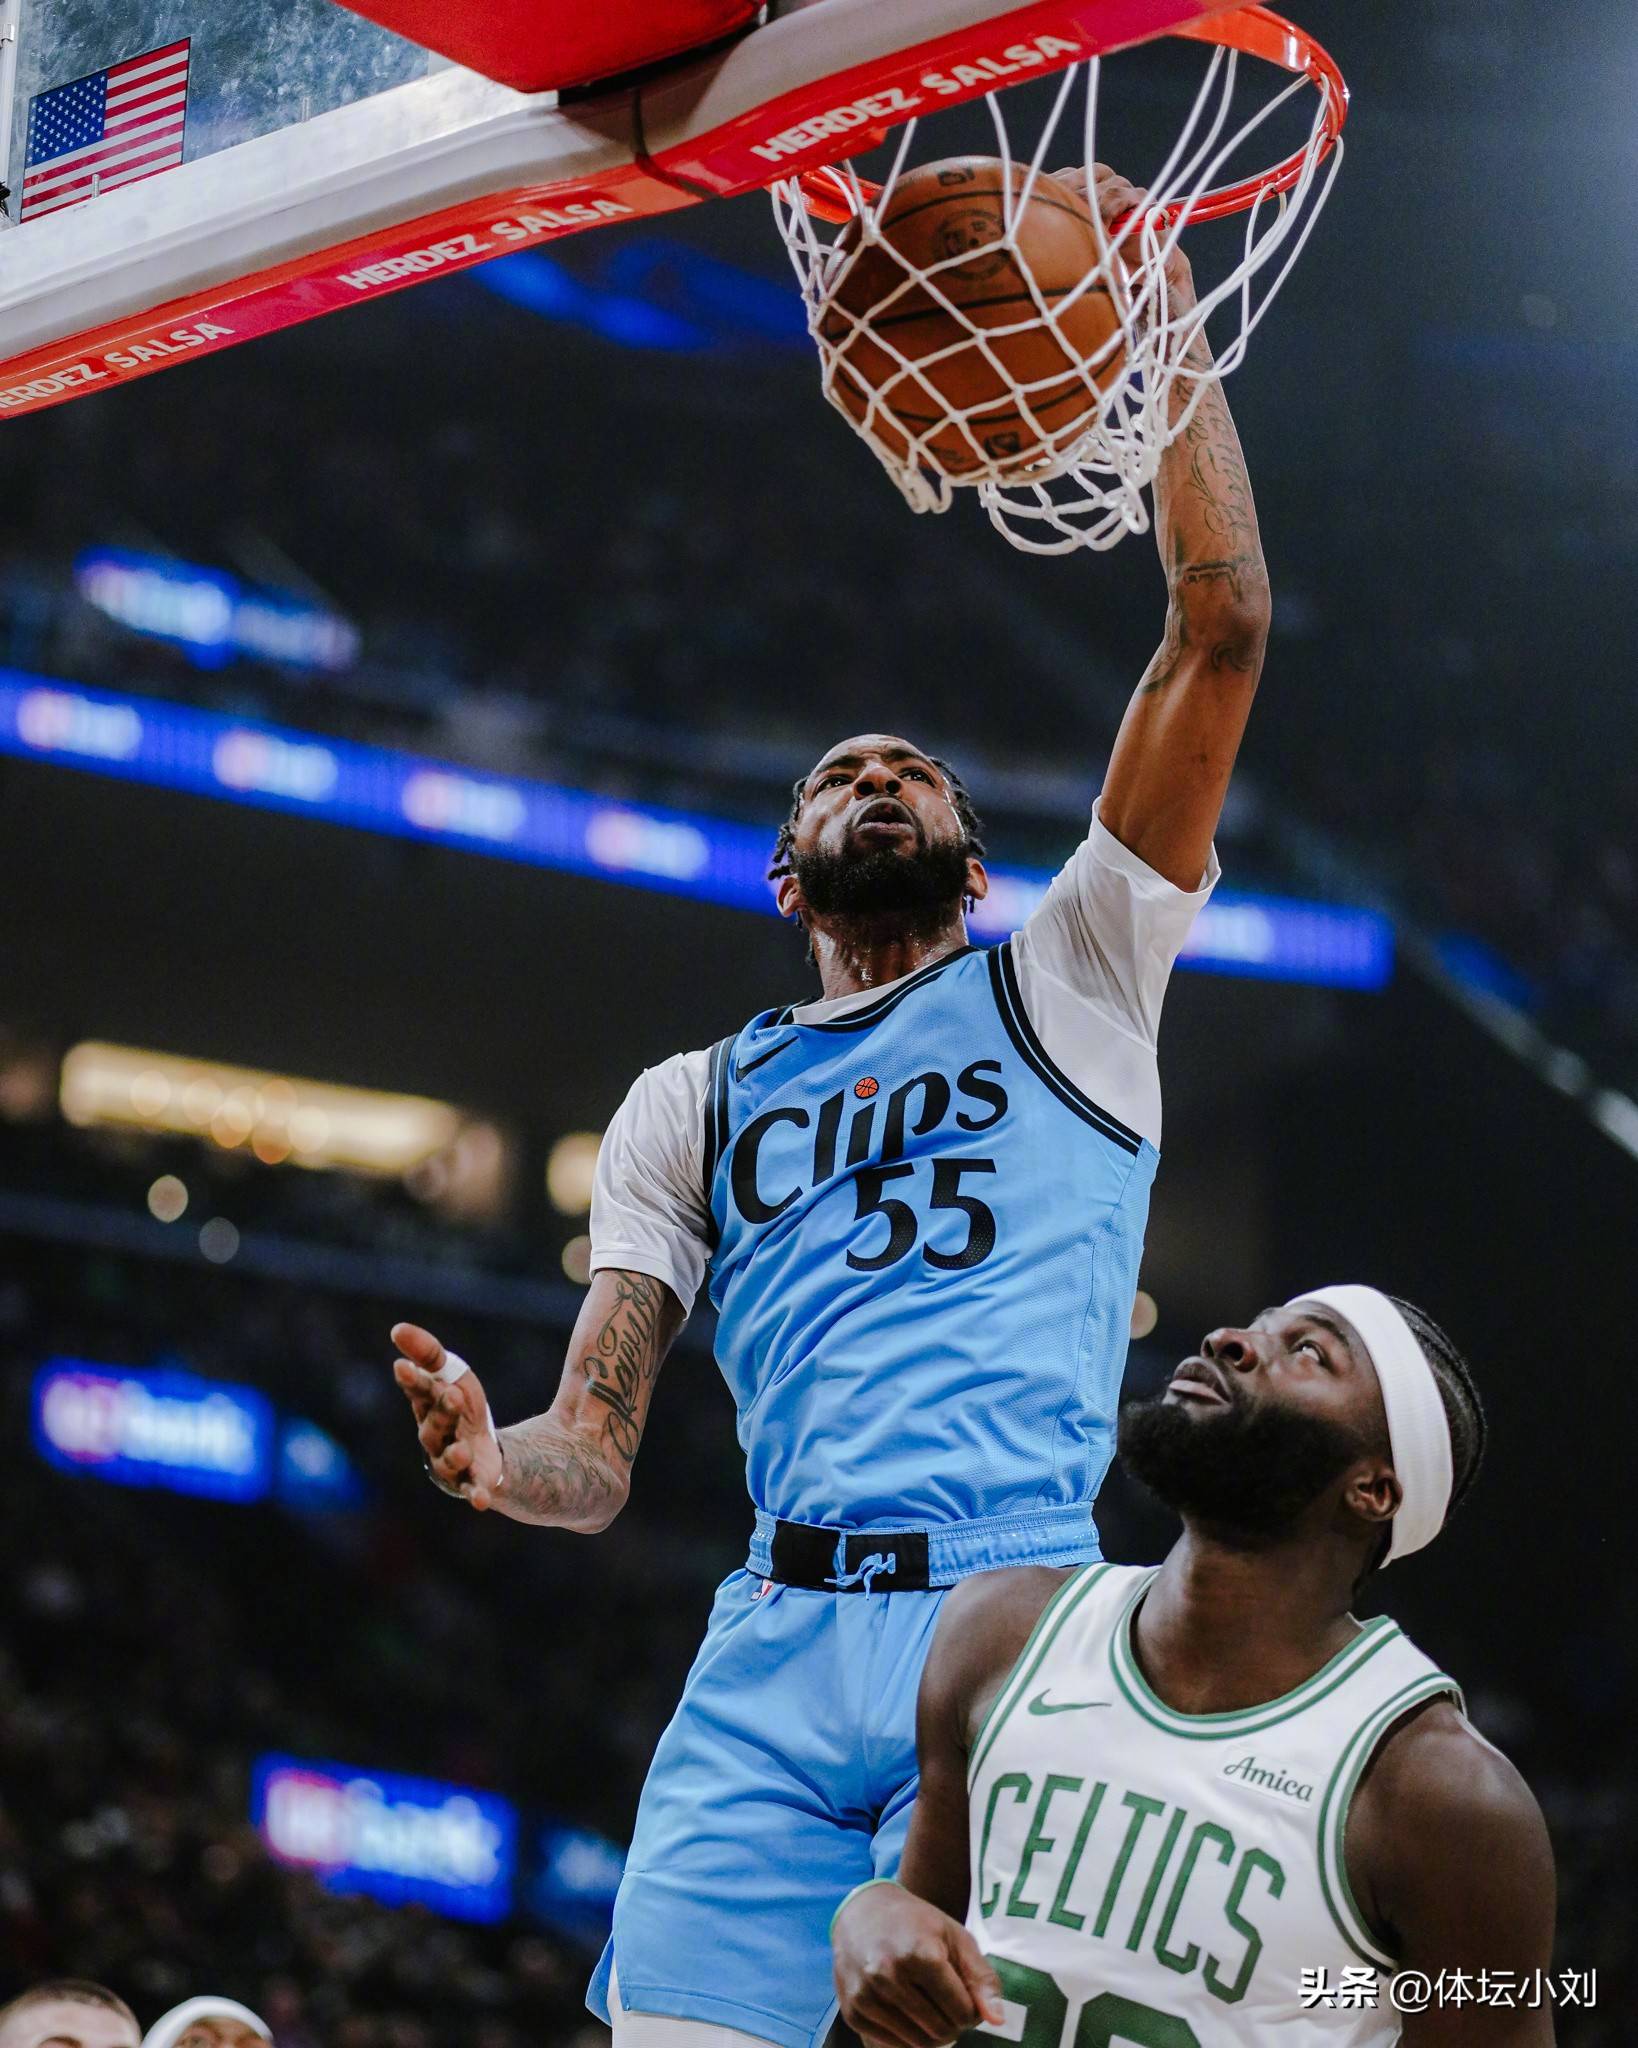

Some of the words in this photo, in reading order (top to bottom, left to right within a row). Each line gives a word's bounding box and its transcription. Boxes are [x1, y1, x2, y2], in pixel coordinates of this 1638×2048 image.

[750, 87, 922, 162] HERDEZ
[920, 34, 1082, 95] SALSA
[336, 233, 493, 290] HERDEZ
[490, 198, 635, 241] SALSA
[0, 363, 108, 409] ERDEZ
[103, 322, 236, 369] SALSA
[730, 1059, 1009, 1225] Clips
[845, 1157, 997, 1272] 55
[1223, 1755, 1315, 1803] Amica
[979, 1772, 1287, 2005] CELTICS
